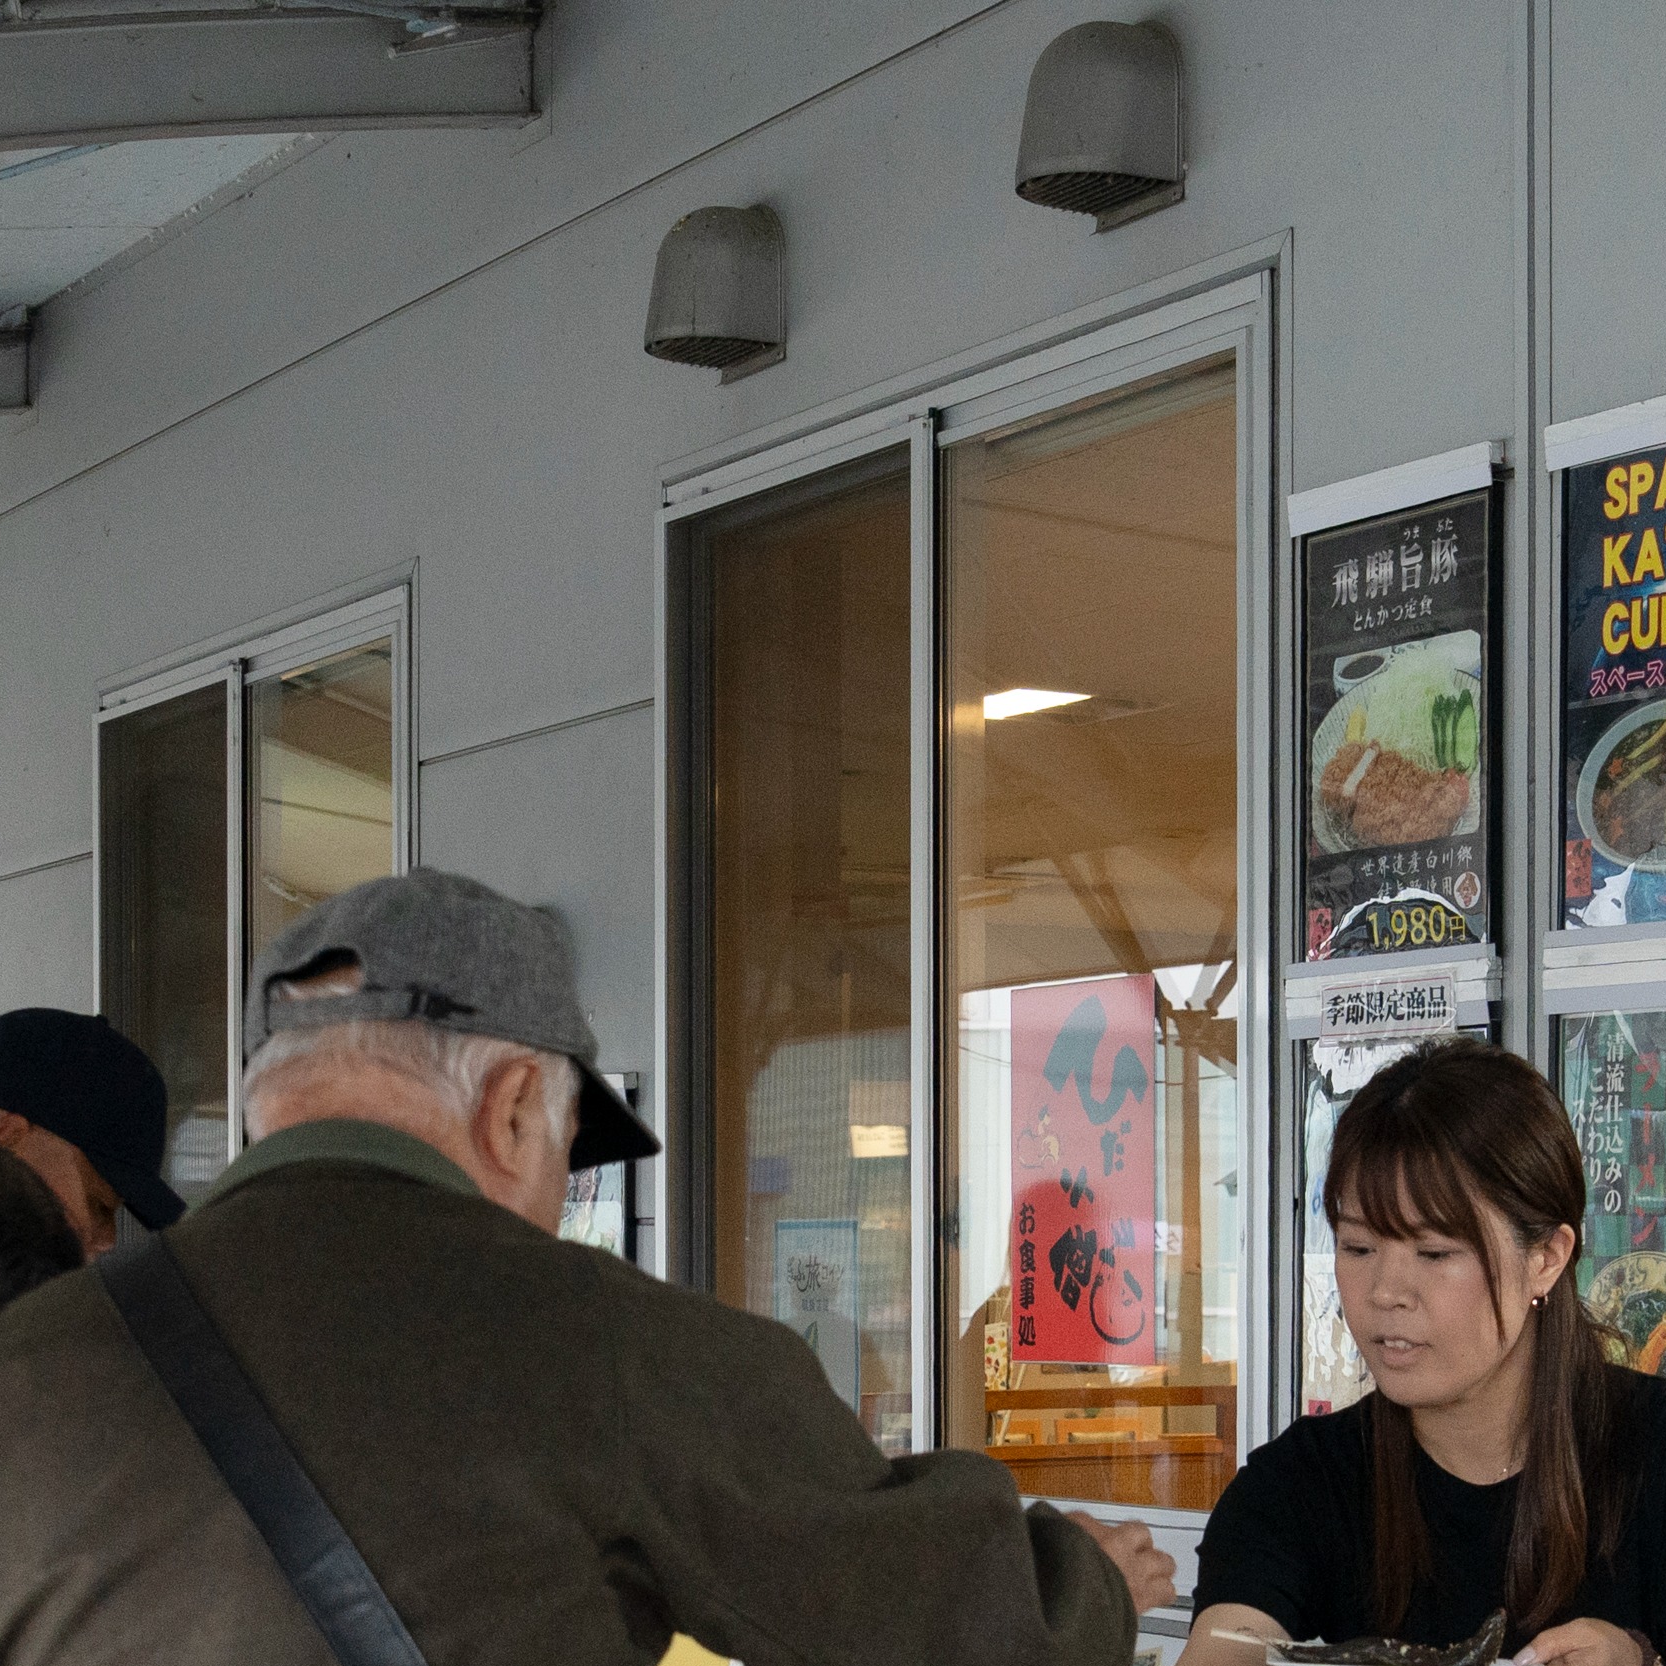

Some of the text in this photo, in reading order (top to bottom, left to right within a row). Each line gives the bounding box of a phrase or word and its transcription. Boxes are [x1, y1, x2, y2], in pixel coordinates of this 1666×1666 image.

[1331, 533, 1459, 608] 飛騨旨豚
[1353, 594, 1433, 632] とんかつ定食
[1368, 904, 1465, 950] 1,980円
[1326, 985, 1447, 1026] 季節限定商品
[1587, 1065, 1606, 1186] こだわり
[1603, 1033, 1627, 1214] 清流仕込みの
[1017, 1202, 1036, 1348] お食事処
